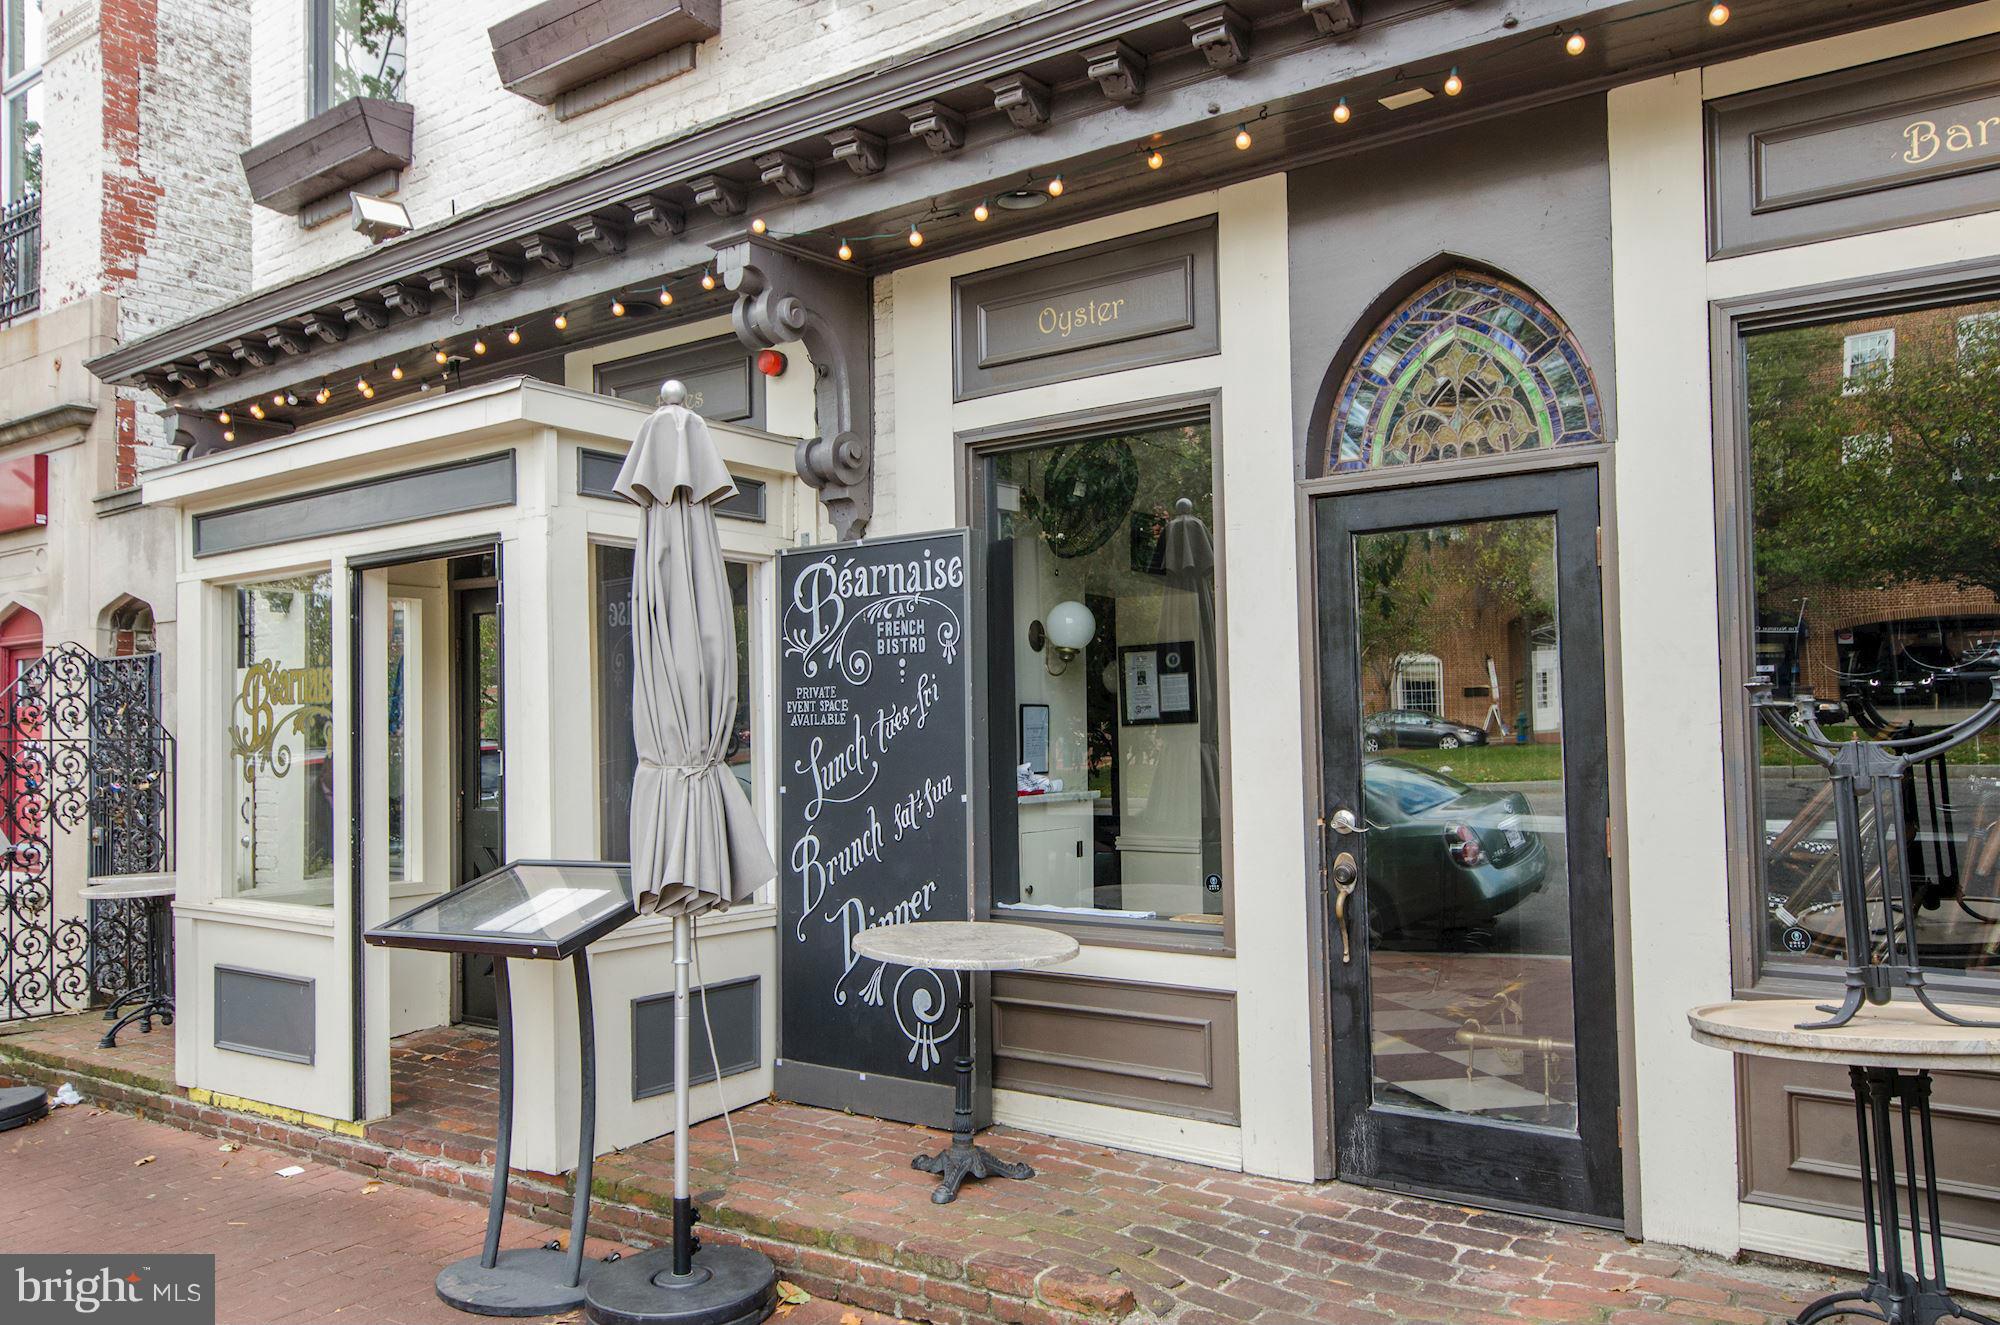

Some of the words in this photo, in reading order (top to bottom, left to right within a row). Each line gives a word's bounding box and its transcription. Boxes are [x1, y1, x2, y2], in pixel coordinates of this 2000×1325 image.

[1903, 117, 2000, 164] Bar
[1038, 299, 1124, 337] Oyster
[793, 549, 964, 646] Béarnaise
[876, 619, 925, 637] FRENCH
[877, 637, 926, 655] BISTRO
[796, 685, 837, 699] PRIVATE
[787, 700, 816, 714] EVENT
[819, 699, 849, 713] SPACE
[790, 713, 847, 727] AVAILABLE
[795, 714, 870, 821] Lunch
[791, 805, 884, 942] Brunch
